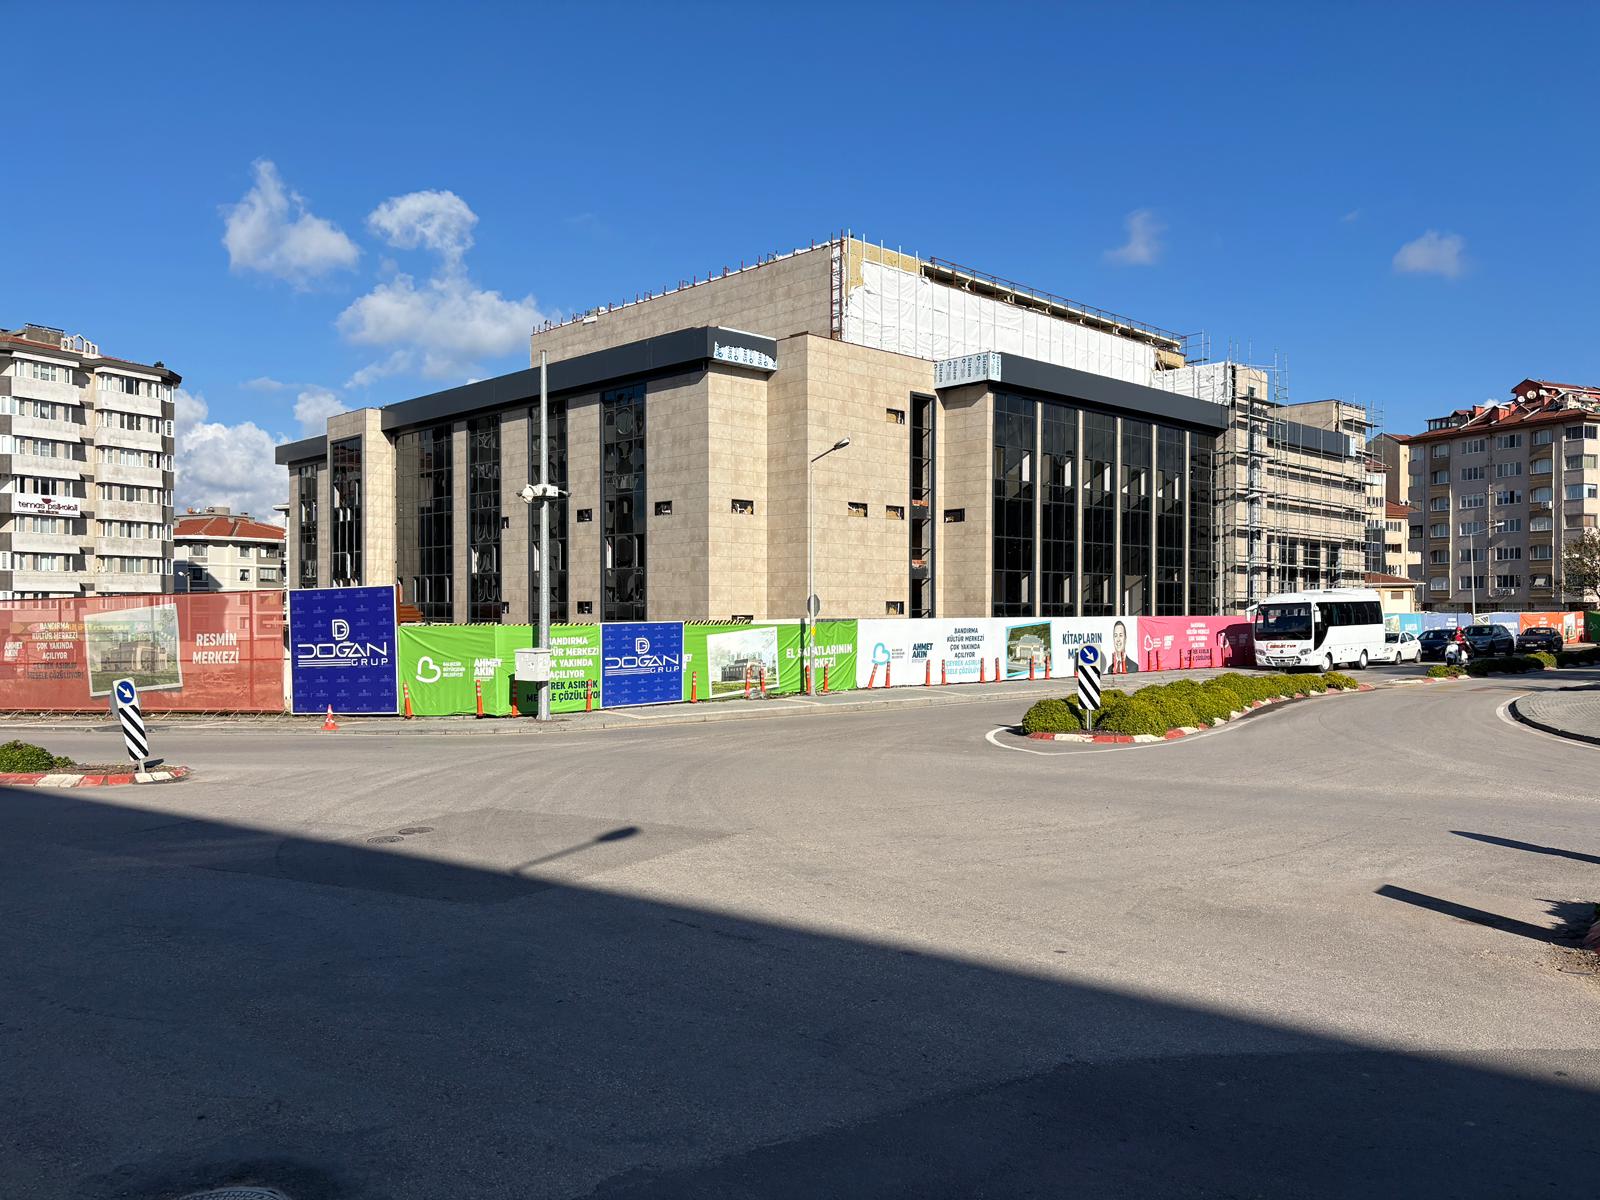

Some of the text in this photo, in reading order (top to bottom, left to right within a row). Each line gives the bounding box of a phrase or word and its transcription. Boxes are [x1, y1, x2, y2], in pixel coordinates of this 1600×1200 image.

[18, 500, 46, 509] temas
[196, 629, 237, 647] RESMİN
[549, 636, 588, 645] ANDIRMA
[1062, 630, 1103, 645] KİTAPLARIN
[49, 641, 74, 650] YAKINDA
[912, 642, 934, 651] AHMET
[566, 645, 599, 656] MERKEZİ
[786, 648, 796, 659] EL
[911, 650, 928, 659] AKIN
[42, 651, 68, 661] AÇILIYOR
[192, 647, 239, 665] MERKEZİ
[351, 658, 388, 666] GRUP
[559, 658, 593, 667] YAKINDA
[650, 665, 680, 674] GRUP
[549, 669, 585, 681] AÇILIYOR
